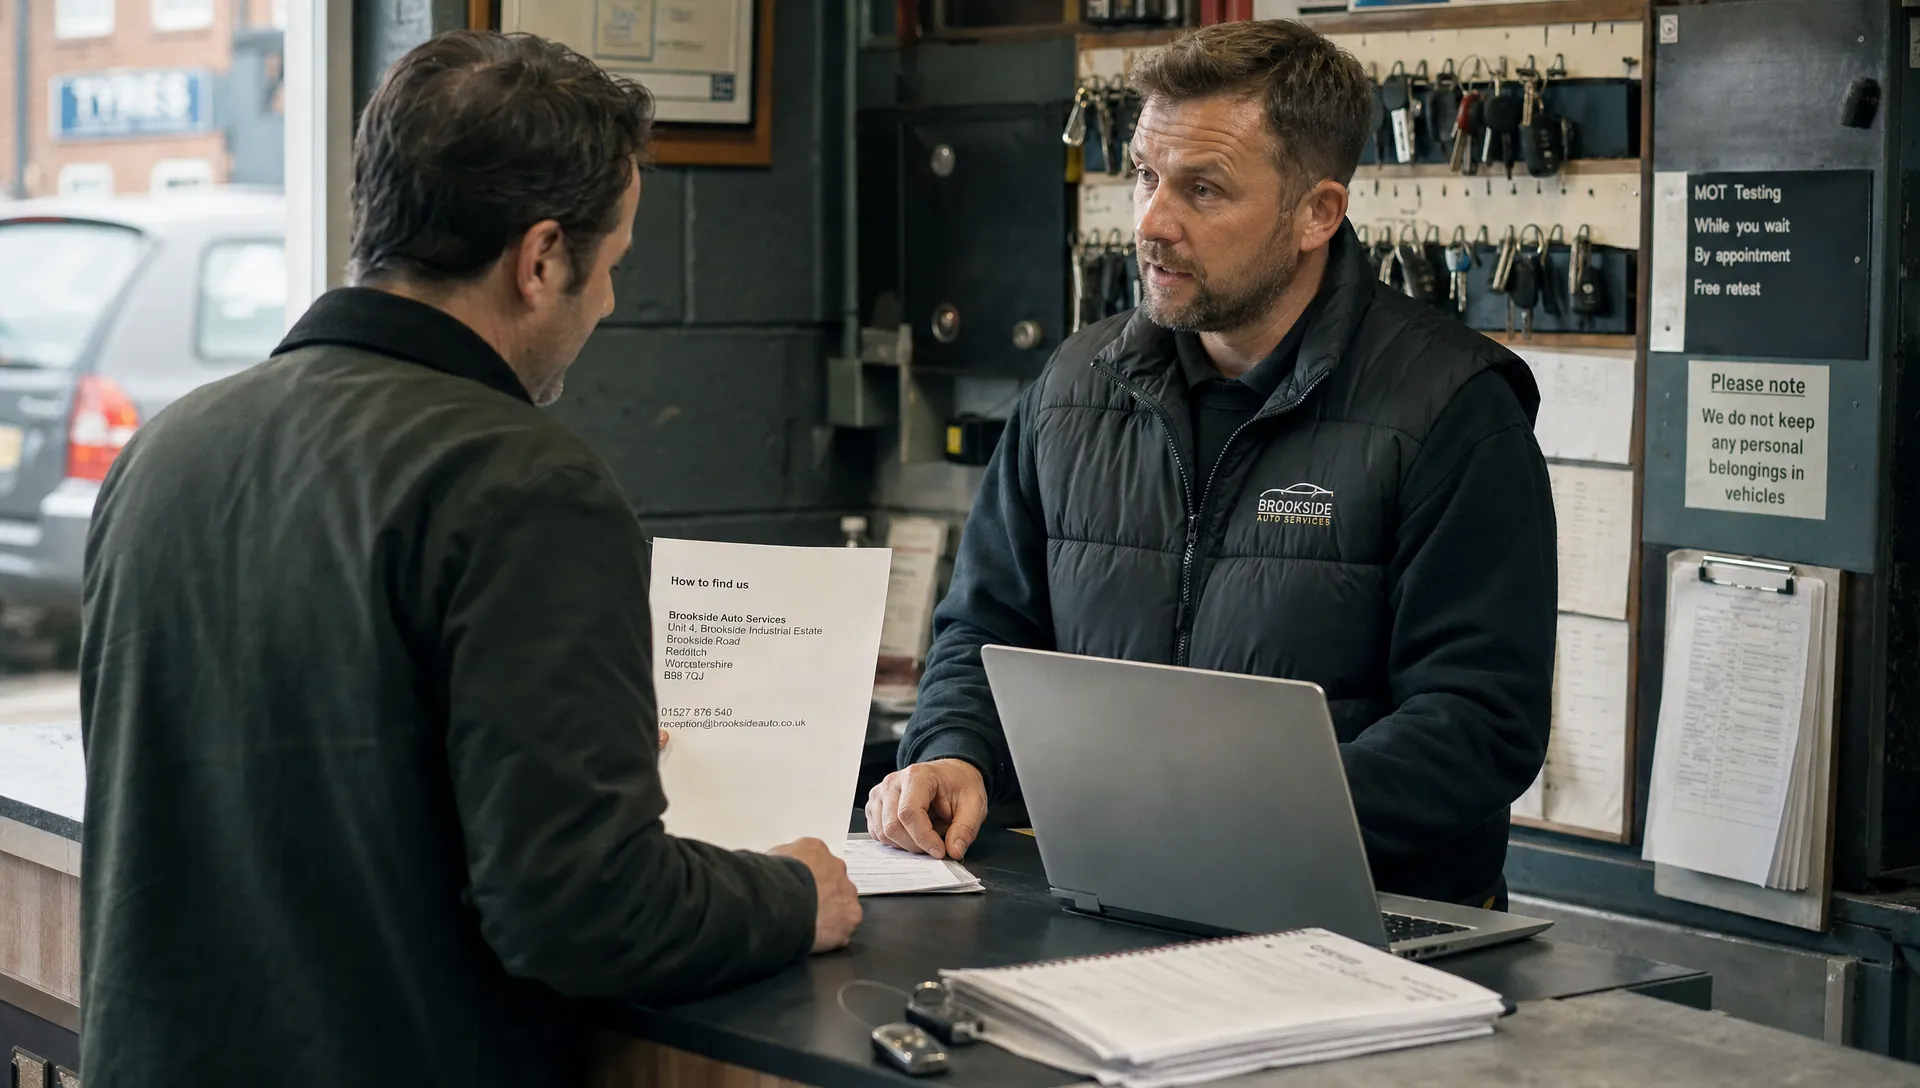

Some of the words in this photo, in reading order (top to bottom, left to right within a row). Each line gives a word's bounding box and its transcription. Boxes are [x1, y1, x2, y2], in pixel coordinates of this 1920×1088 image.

[1694, 184, 1728, 200] MOT
[1734, 184, 1782, 204] Testing
[1694, 218, 1730, 233] While
[1736, 221, 1760, 237] you
[1765, 218, 1790, 233] wait
[1694, 247, 1711, 266] By
[1716, 247, 1791, 266] appointment
[1694, 279, 1720, 295] Free
[1726, 282, 1761, 296] retest
[1711, 373, 1764, 392] Please
[1769, 377, 1806, 394] note
[1702, 408, 1724, 424] We
[1729, 410, 1746, 426] do
[1751, 412, 1774, 428] not
[1779, 412, 1815, 433] keep
[1712, 437, 1736, 454] any
[1740, 439, 1804, 455] personal
[1709, 459, 1787, 482] belongings
[1791, 464, 1804, 480] in
[1725, 487, 1785, 505] vehicles
[1258, 499, 1332, 515] BROOKSIDE
[1284, 516, 1331, 526] SERVICES
[671, 576, 695, 588] How
[698, 578, 709, 588] to
[712, 578, 733, 589] find
[736, 581, 749, 589] us
[669, 611, 719, 622] Brookside
[720, 614, 743, 622] Auto
[746, 614, 786, 624] Services
[668, 623, 686, 632] Unit
[700, 624, 746, 634] Brookside
[749, 626, 792, 635] Industrial
[794, 627, 823, 635] Estate
[667, 635, 713, 645] Brookside
[716, 637, 740, 645] Road
[664, 671, 682, 680] B98
[685, 672, 704, 680] 7QJ
[661, 708, 691, 716] 01527
[694, 708, 712, 716] 876
[714, 708, 732, 716] 540
[660, 719, 806, 729] reception@brooksideauto.co.uk
